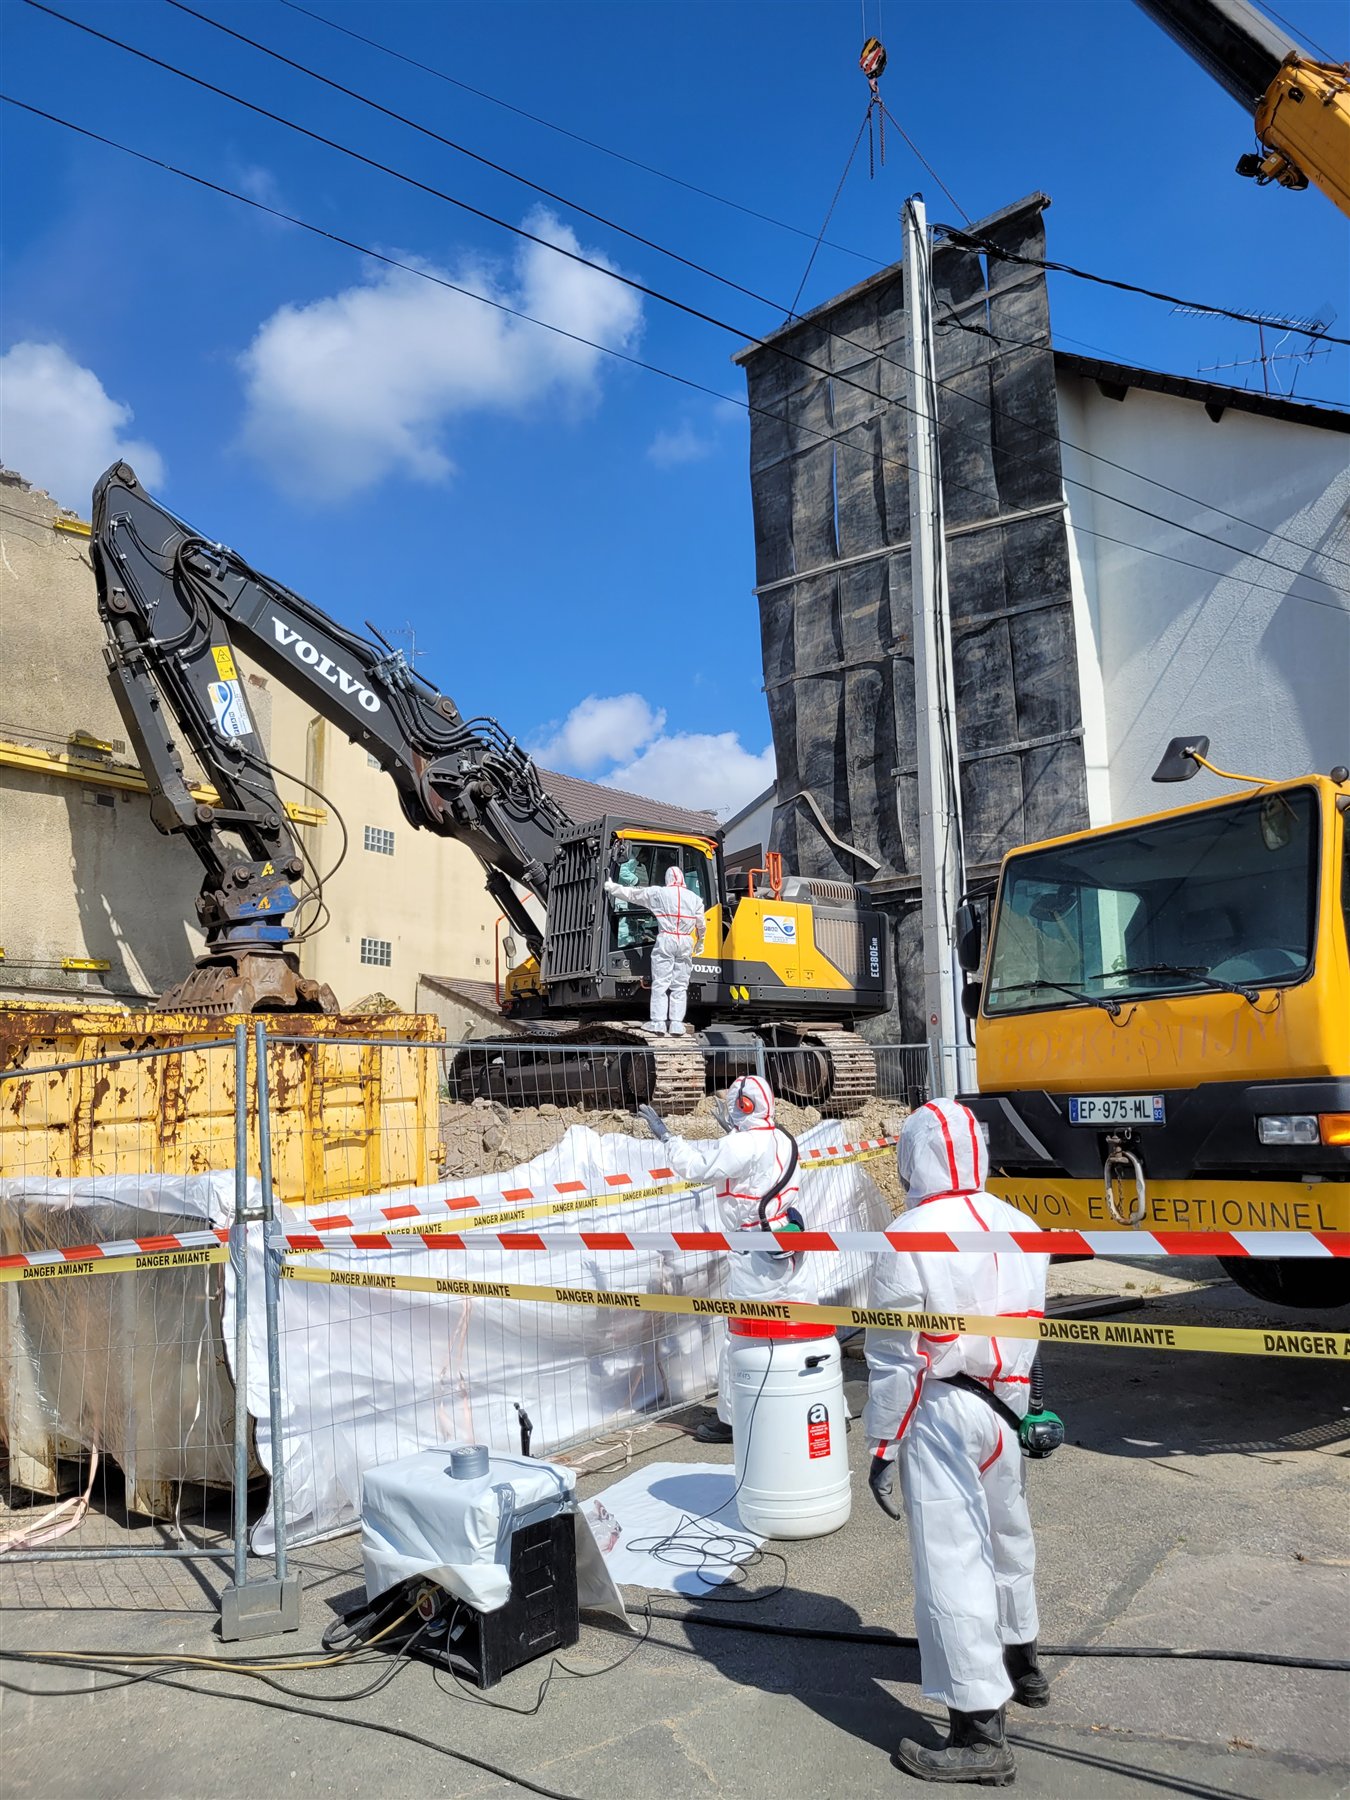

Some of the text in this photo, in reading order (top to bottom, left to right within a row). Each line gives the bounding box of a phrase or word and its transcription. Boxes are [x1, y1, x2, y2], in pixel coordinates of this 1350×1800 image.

[271, 616, 381, 713] VOLVO
[1080, 1100, 1151, 1119] EP-975-ML
[622, 1187, 664, 1201] DANGER AMIANTE
[552, 1198, 598, 1214] DANGER AMIANTE
[993, 1194, 1072, 1217] NVOI
[473, 1210, 526, 1227] DANGER AMIANTE
[136, 1251, 211, 1268] DANGER AMIANTE
[23, 1262, 94, 1279] DANGER AMIANTE
[330, 1271, 397, 1288] DANGER AMIANTE
[436, 1280, 511, 1297] DANGER AMIANTE
[555, 1289, 641, 1308] DANGER AMIANTE
[692, 1299, 791, 1319] DANGER AMIANTE
[851, 1310, 967, 1332] DANGER AMIANTE
[1038, 1321, 1176, 1346] DANGER AMIANTE
[1263, 1334, 1338, 1355] DANGER
